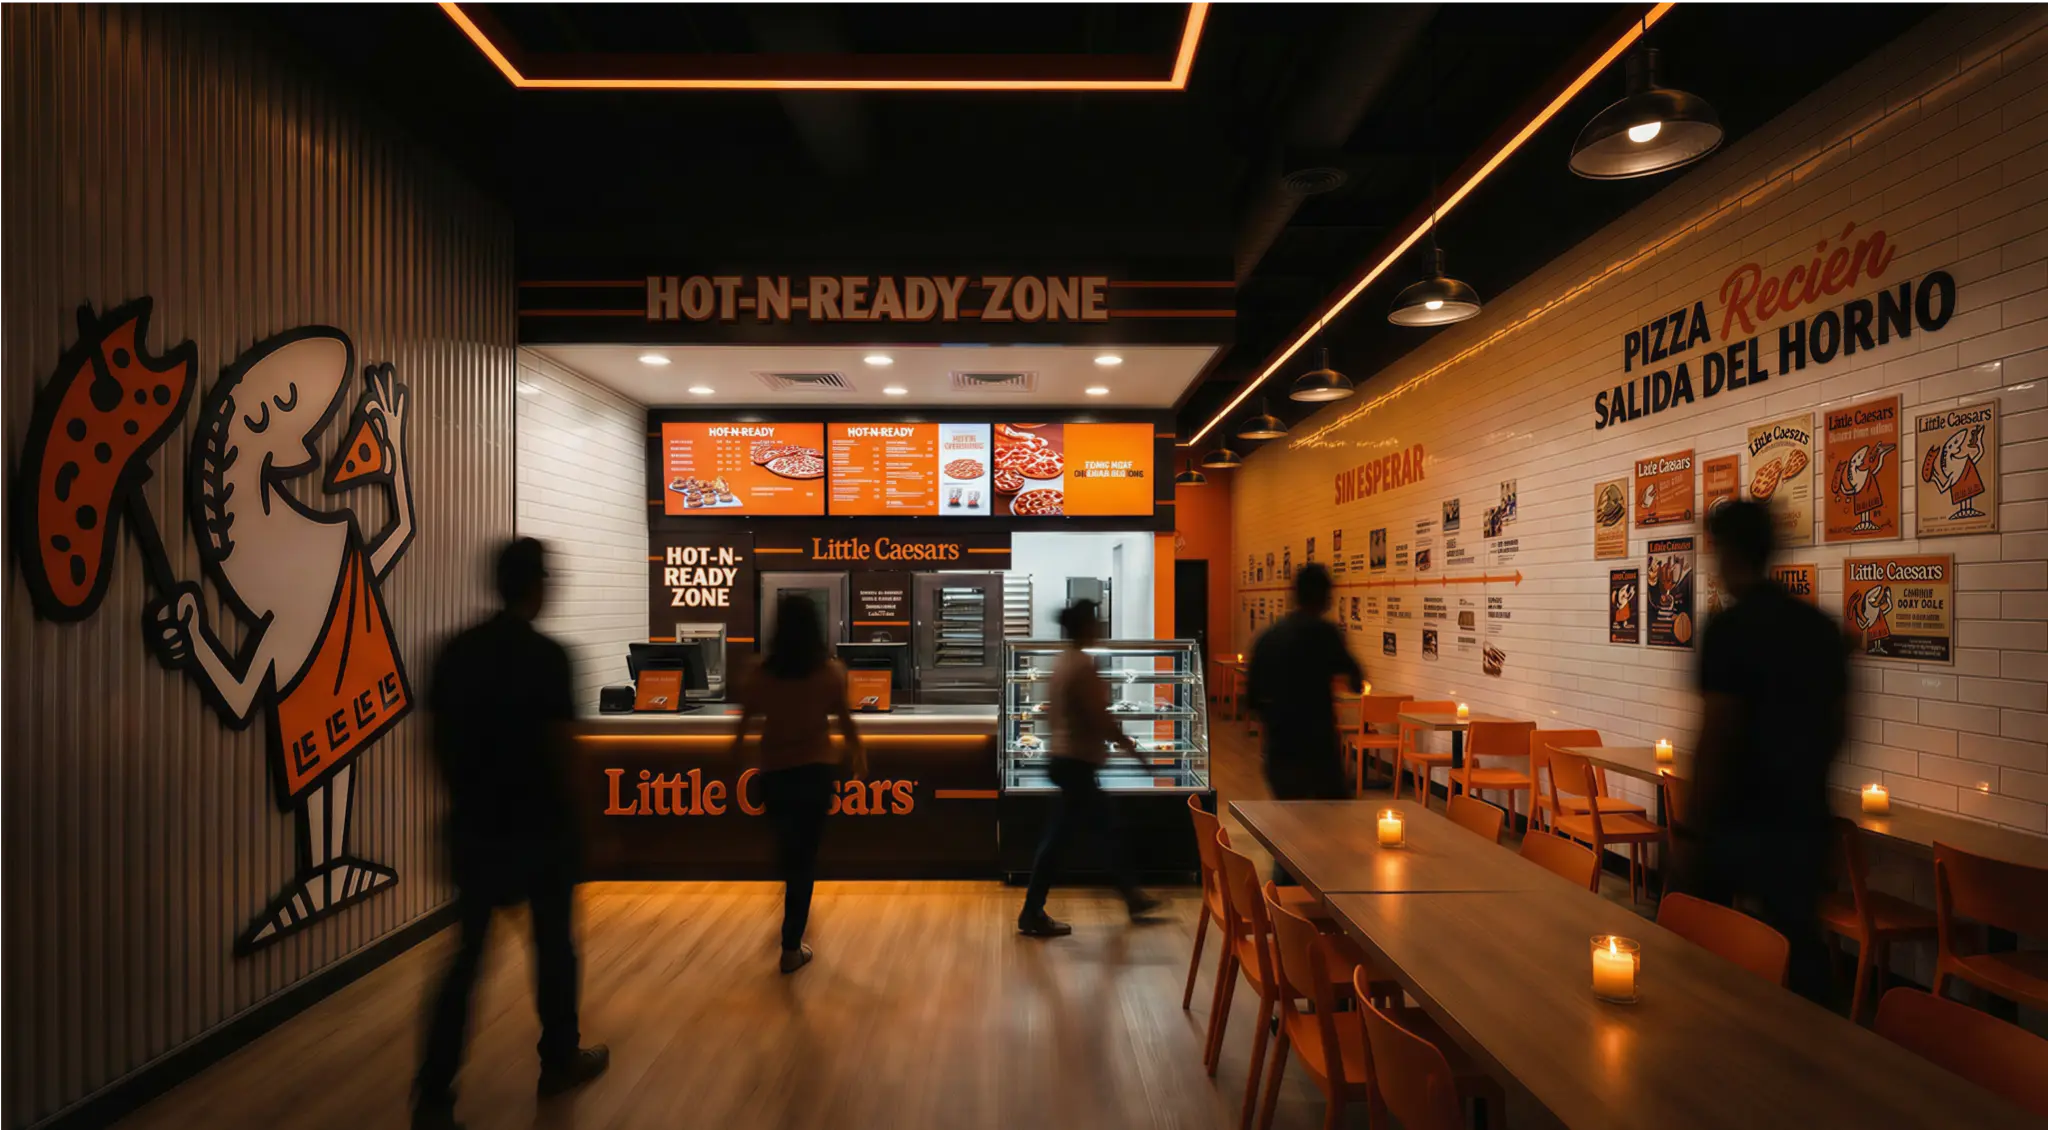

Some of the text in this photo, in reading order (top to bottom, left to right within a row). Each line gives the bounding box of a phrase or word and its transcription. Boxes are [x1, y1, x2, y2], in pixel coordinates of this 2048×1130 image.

[646, 276, 1110, 322] HOT-N-READY ZONE
[1624, 221, 1897, 373] PIZZA Recién
[1595, 270, 1956, 430] SALIDA DEL HORNO
[1947, 408, 1992, 427] Caesars
[847, 427, 915, 438] HOT-N-READY
[1334, 443, 1426, 506] SIN ESPERAR
[666, 547, 743, 566] HOT-N-
[812, 537, 960, 560] Little Caesars
[664, 567, 738, 587] READY
[1886, 561, 1943, 581] Caesars
[671, 588, 730, 607] ZONE
[604, 767, 915, 816] Little Csars
